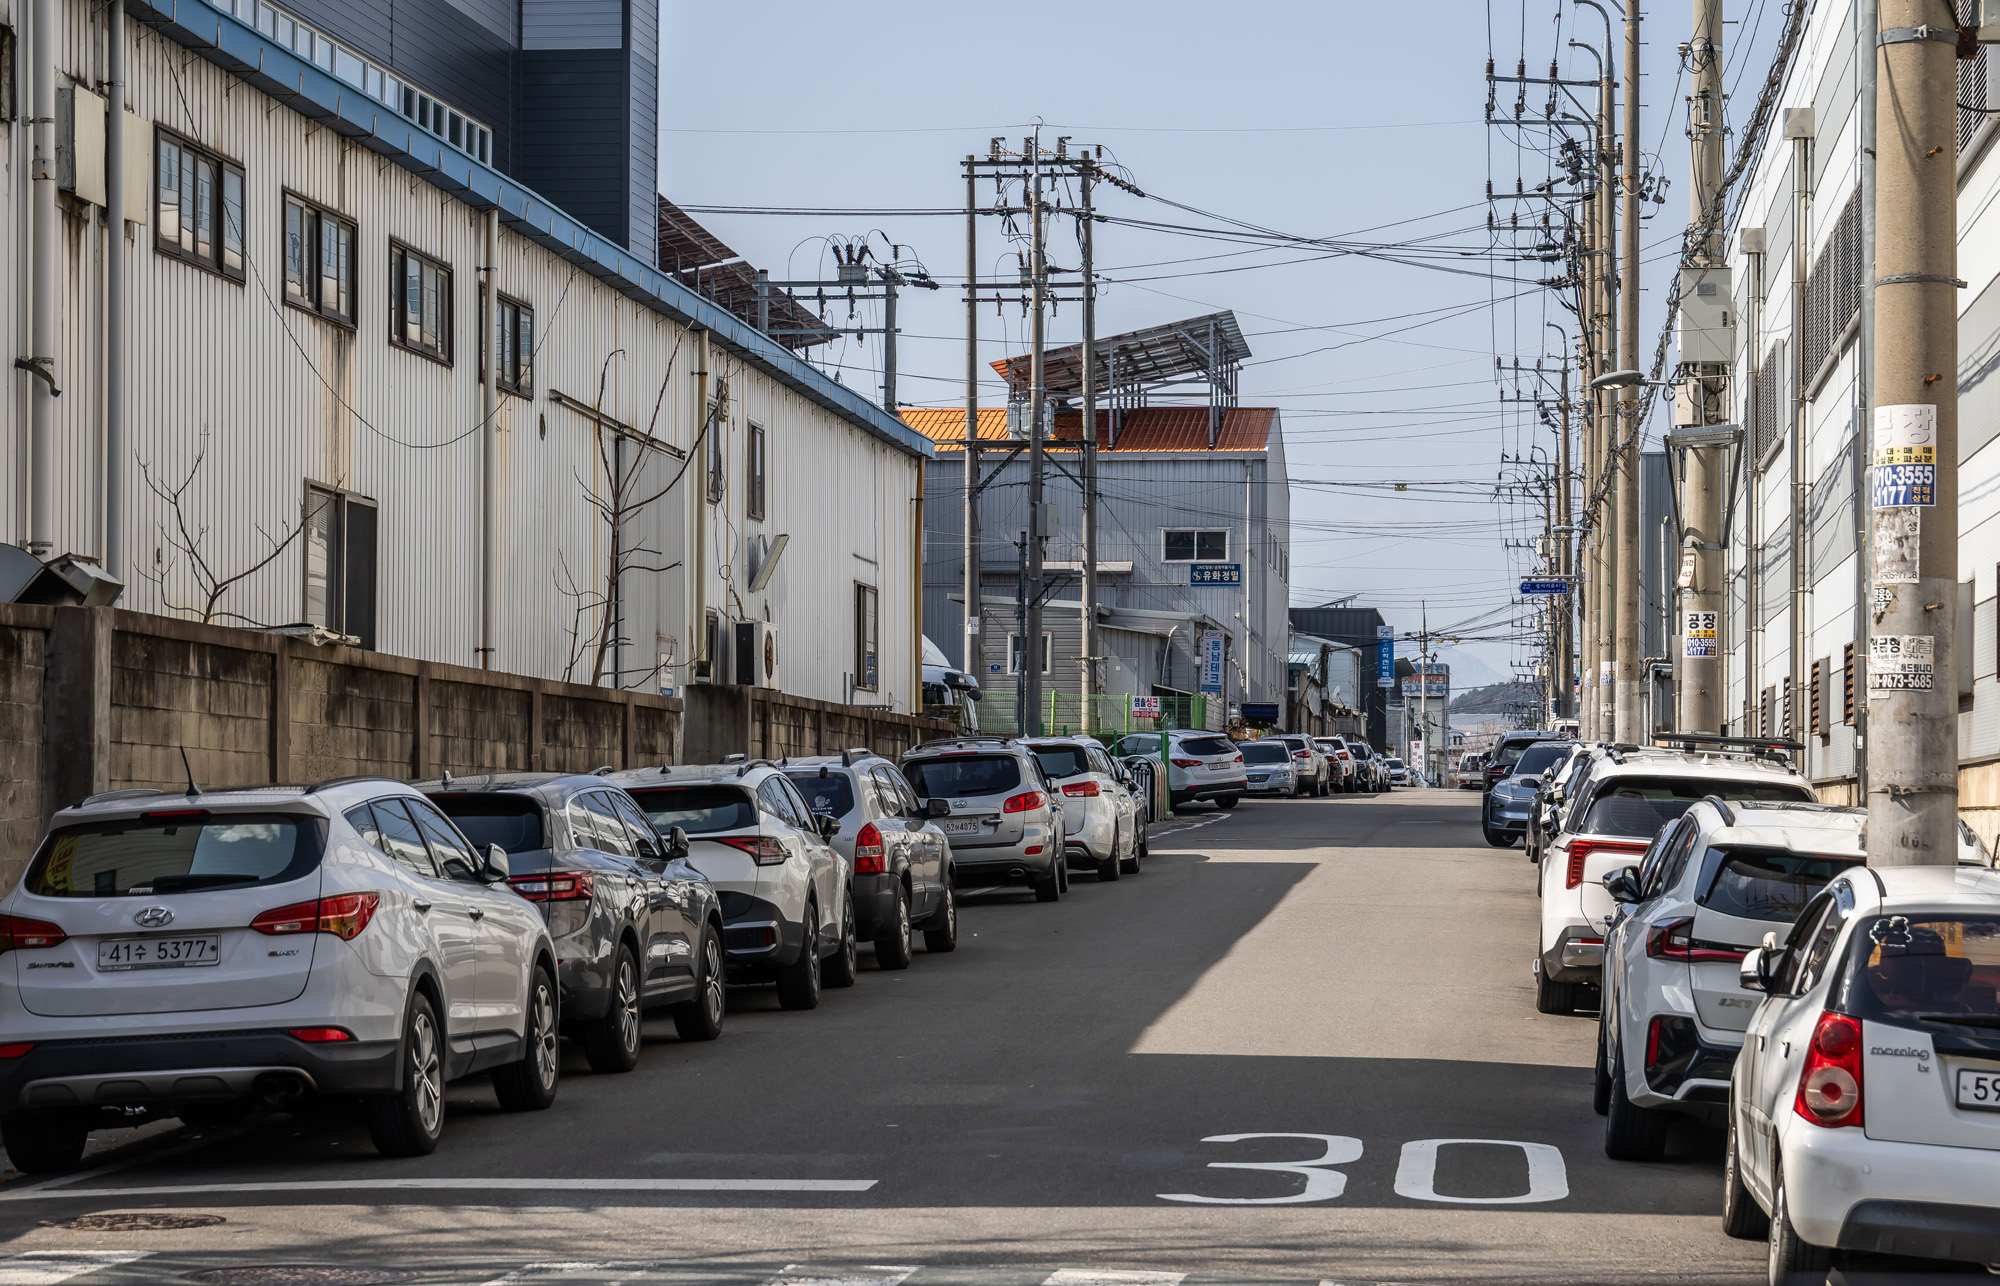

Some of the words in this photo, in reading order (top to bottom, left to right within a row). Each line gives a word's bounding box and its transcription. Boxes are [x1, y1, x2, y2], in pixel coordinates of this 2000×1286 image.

[1875, 465, 1933, 486] 010-3555
[1203, 570, 1239, 581] 유화정밀
[1688, 613, 1716, 630] 공장
[1687, 638, 1716, 648] 010-3555
[1210, 640, 1221, 684] 동남테크
[109, 943, 147, 962] 41수
[157, 940, 207, 960] 5377
[1870, 1046, 1930, 1061] morning
[1155, 1132, 1570, 1205] 30
